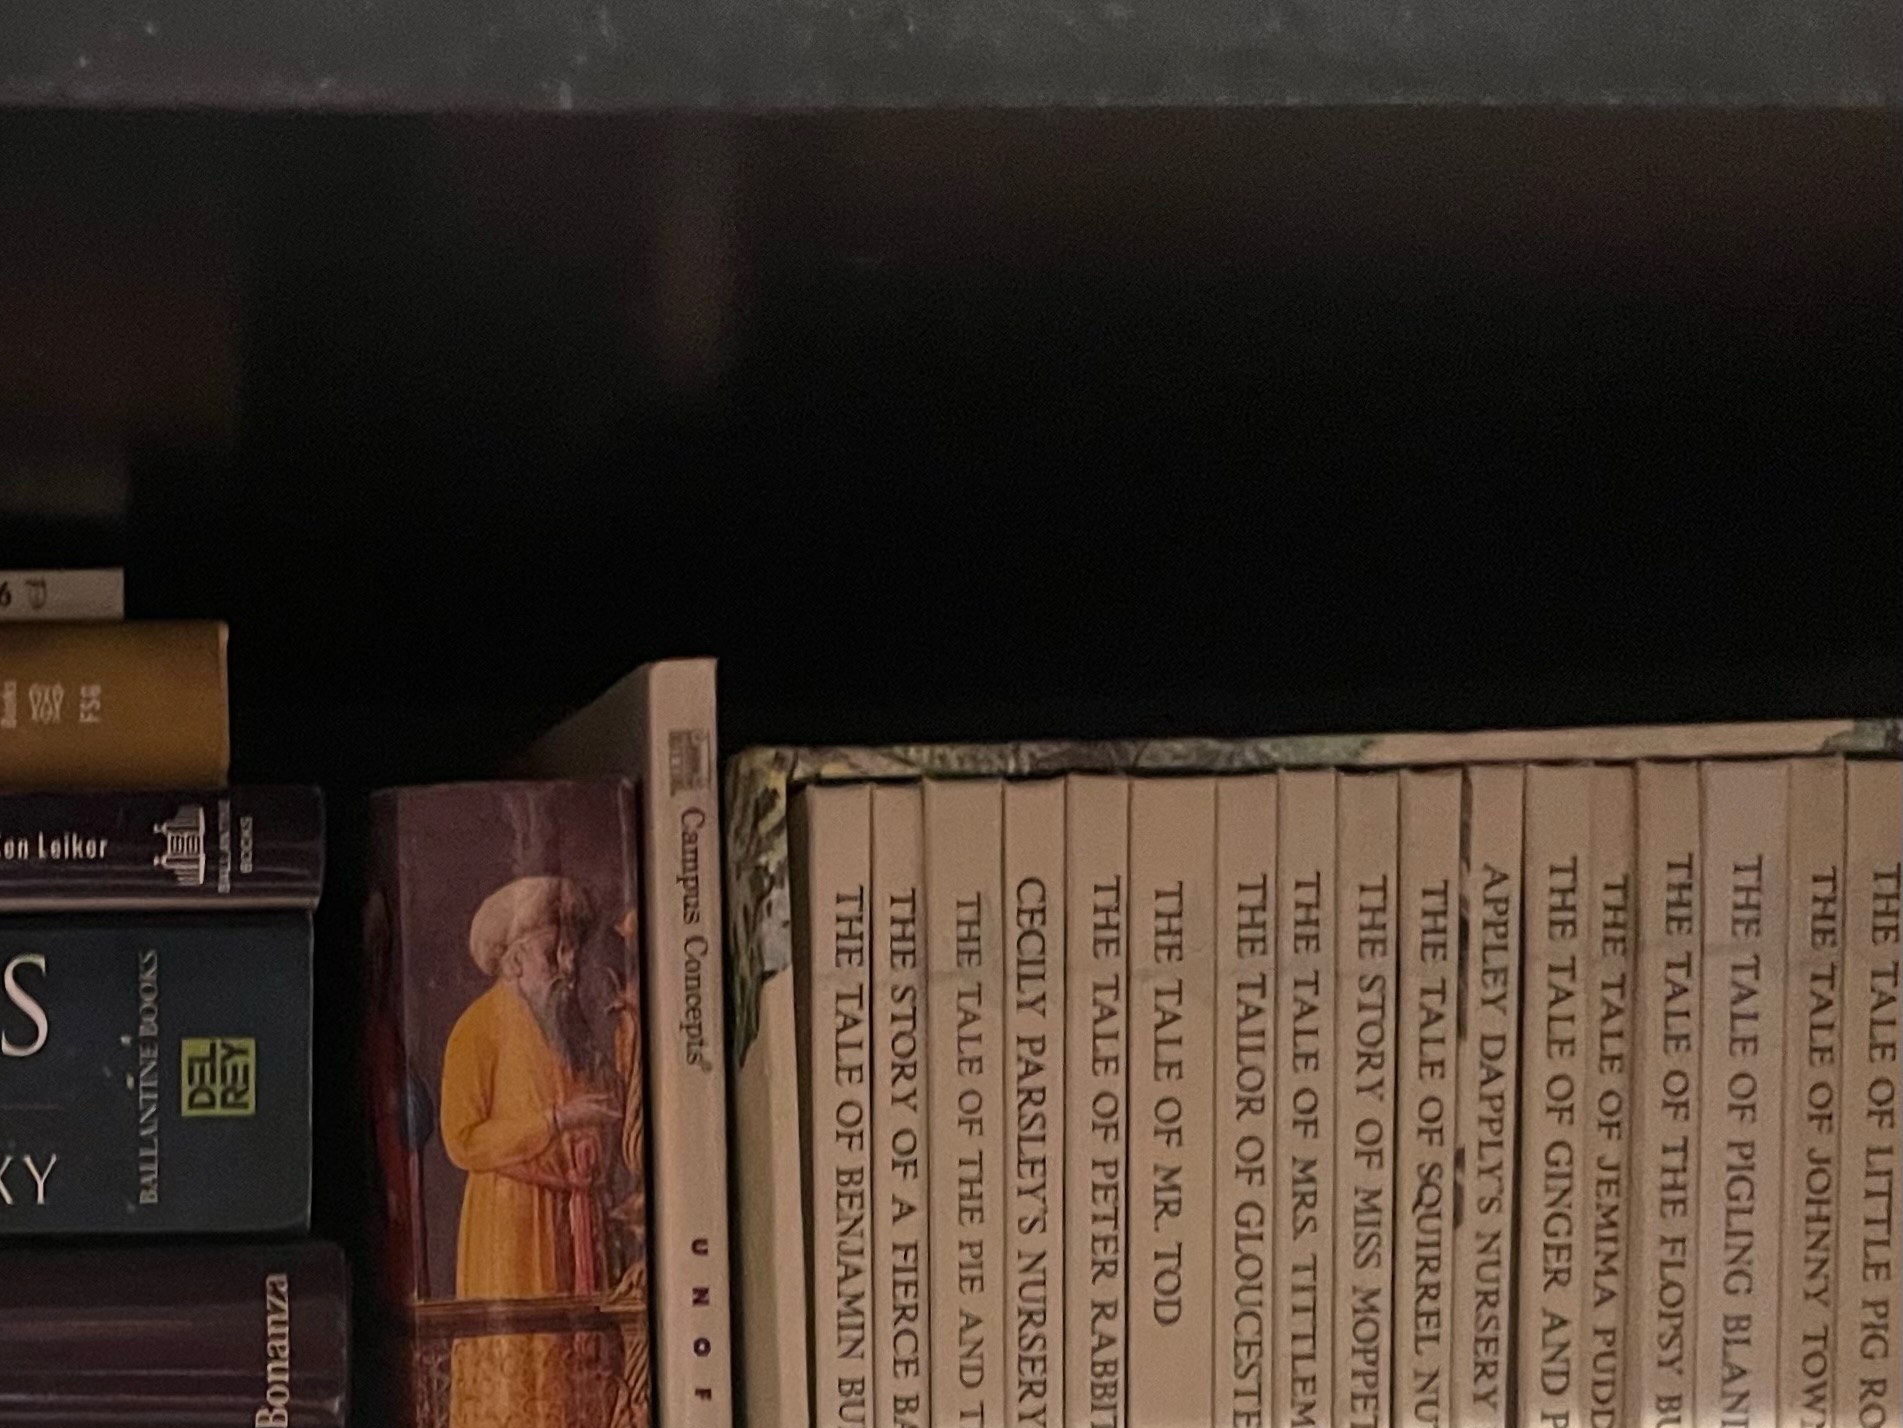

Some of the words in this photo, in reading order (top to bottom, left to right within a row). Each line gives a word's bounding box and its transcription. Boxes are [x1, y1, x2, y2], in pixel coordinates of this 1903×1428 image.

[37, 832, 108, 861] Leiker
[676, 806, 706, 925] Campus
[836, 884, 863, 968] THE
[1154, 882, 1183, 963] THE
[1666, 853, 1693, 937] THE
[1732, 854, 1763, 939] THE
[1016, 877, 1046, 1019] CECILY
[138, 950, 158, 1036] BOOKS
[835, 984, 863, 1086] TALE
[1154, 980, 1183, 1082] TALE
[1663, 952, 1692, 1056] TALE
[1729, 955, 1761, 1058] TALE
[187, 1041, 216, 1109] DEL
[220, 1041, 250, 1109] REY
[1662, 1070, 1690, 1122] OF
[1727, 1073, 1757, 1123] OF
[138, 1037, 159, 1204] BALLANTINE
[836, 1101, 863, 1151] OF
[1016, 1036, 1046, 1233] PARSLEY'S
[1154, 1097, 1182, 1147] OF
[1154, 1163, 1182, 1232] MR.
[1660, 1137, 1689, 1220] THE
[1723, 1142, 1755, 1296] PIGLING
[836, 1168, 864, 1359] BENJAMIN
[1154, 1243, 1181, 1327] TOD
[1657, 1235, 1686, 1376] FLOPSY
